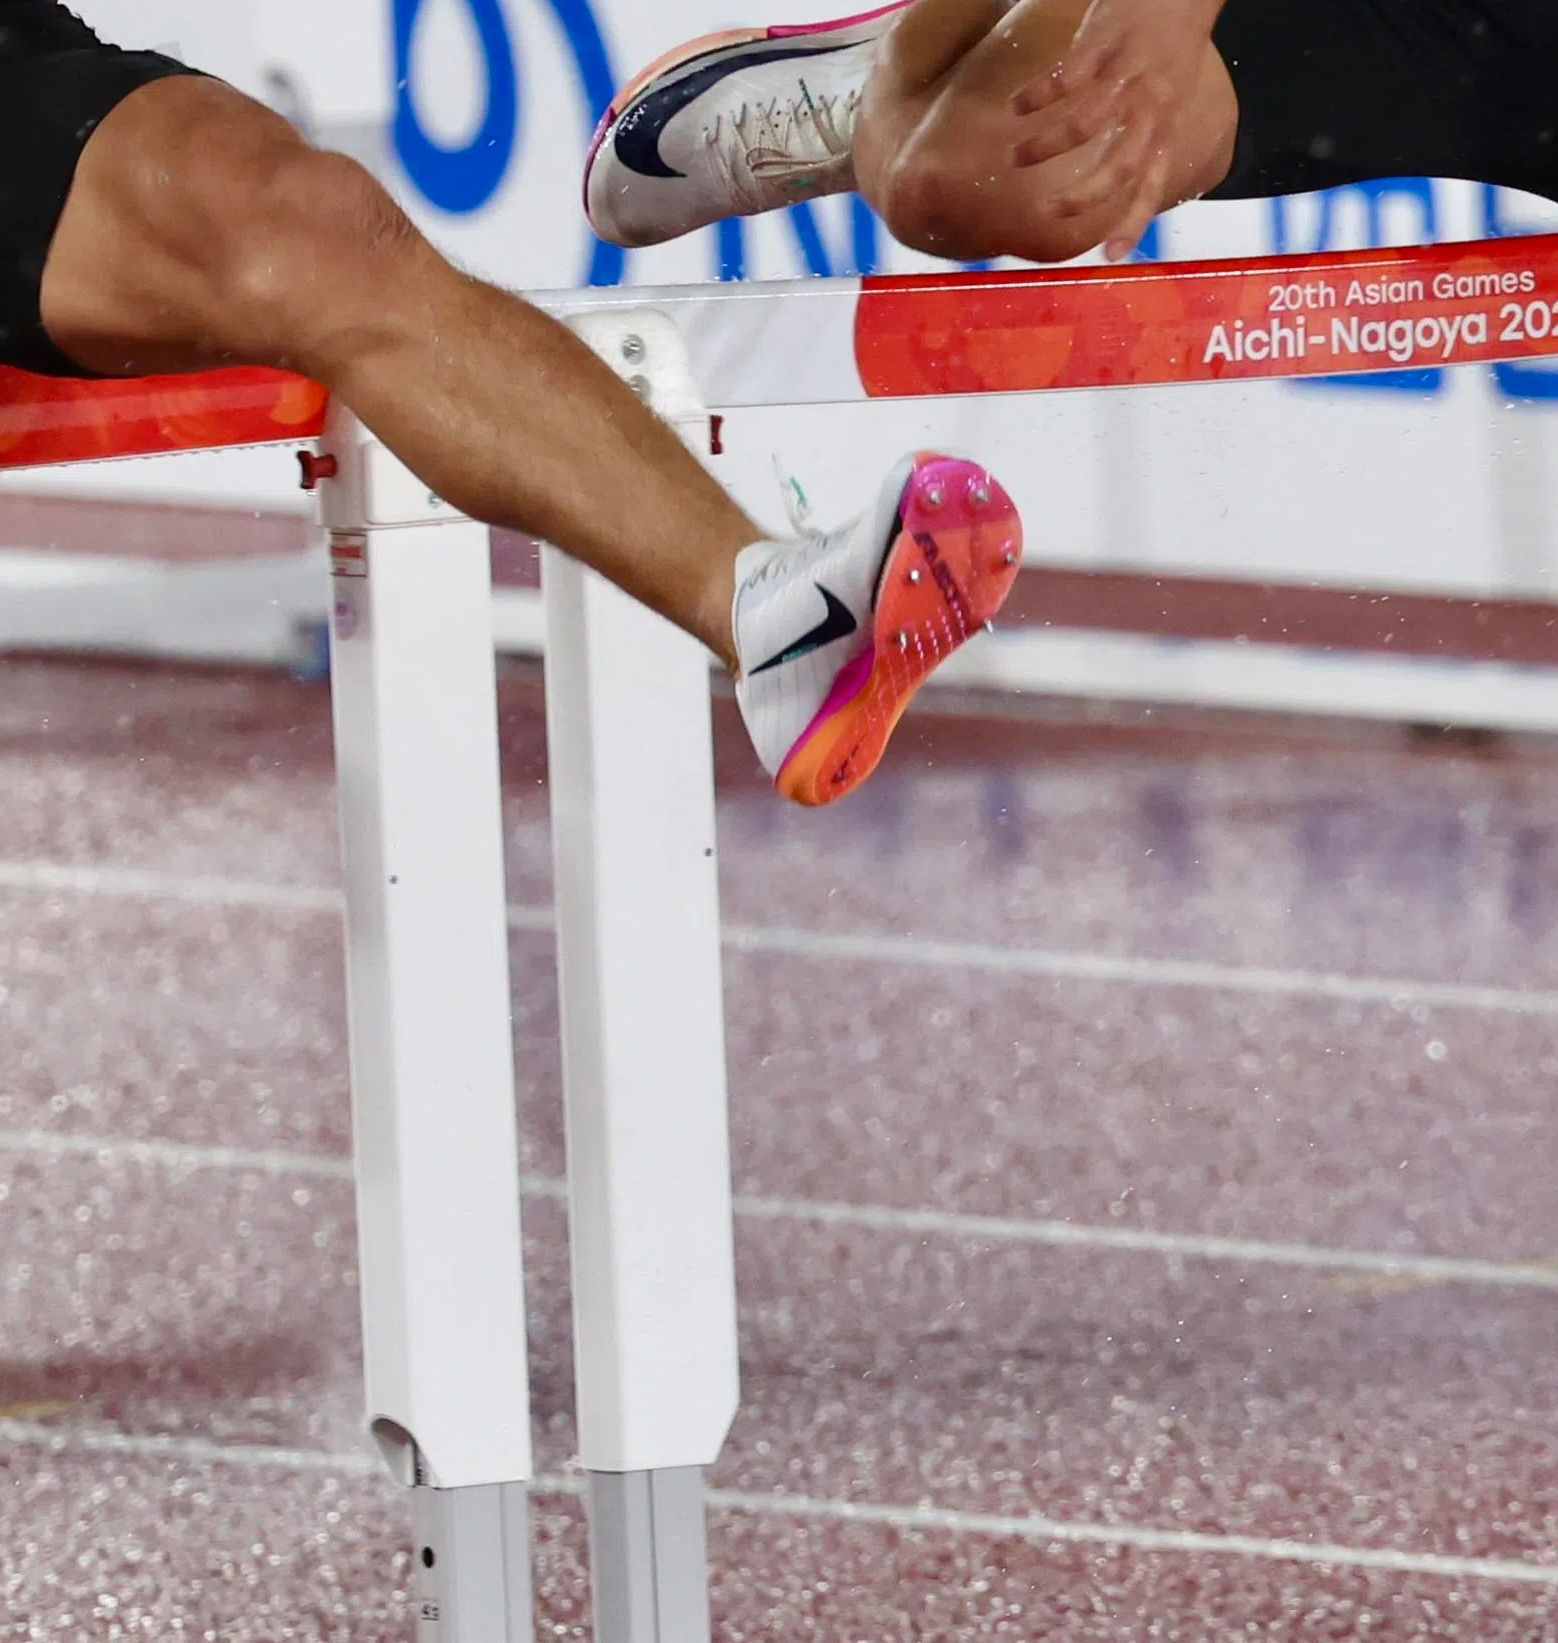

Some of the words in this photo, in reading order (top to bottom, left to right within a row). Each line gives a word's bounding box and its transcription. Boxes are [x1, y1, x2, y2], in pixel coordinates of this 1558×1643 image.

[1268, 279, 1336, 312] 20th
[1345, 274, 1424, 306] Asian
[1432, 270, 1536, 301] Games
[1202, 311, 1488, 364] Aichi-Nagoya
